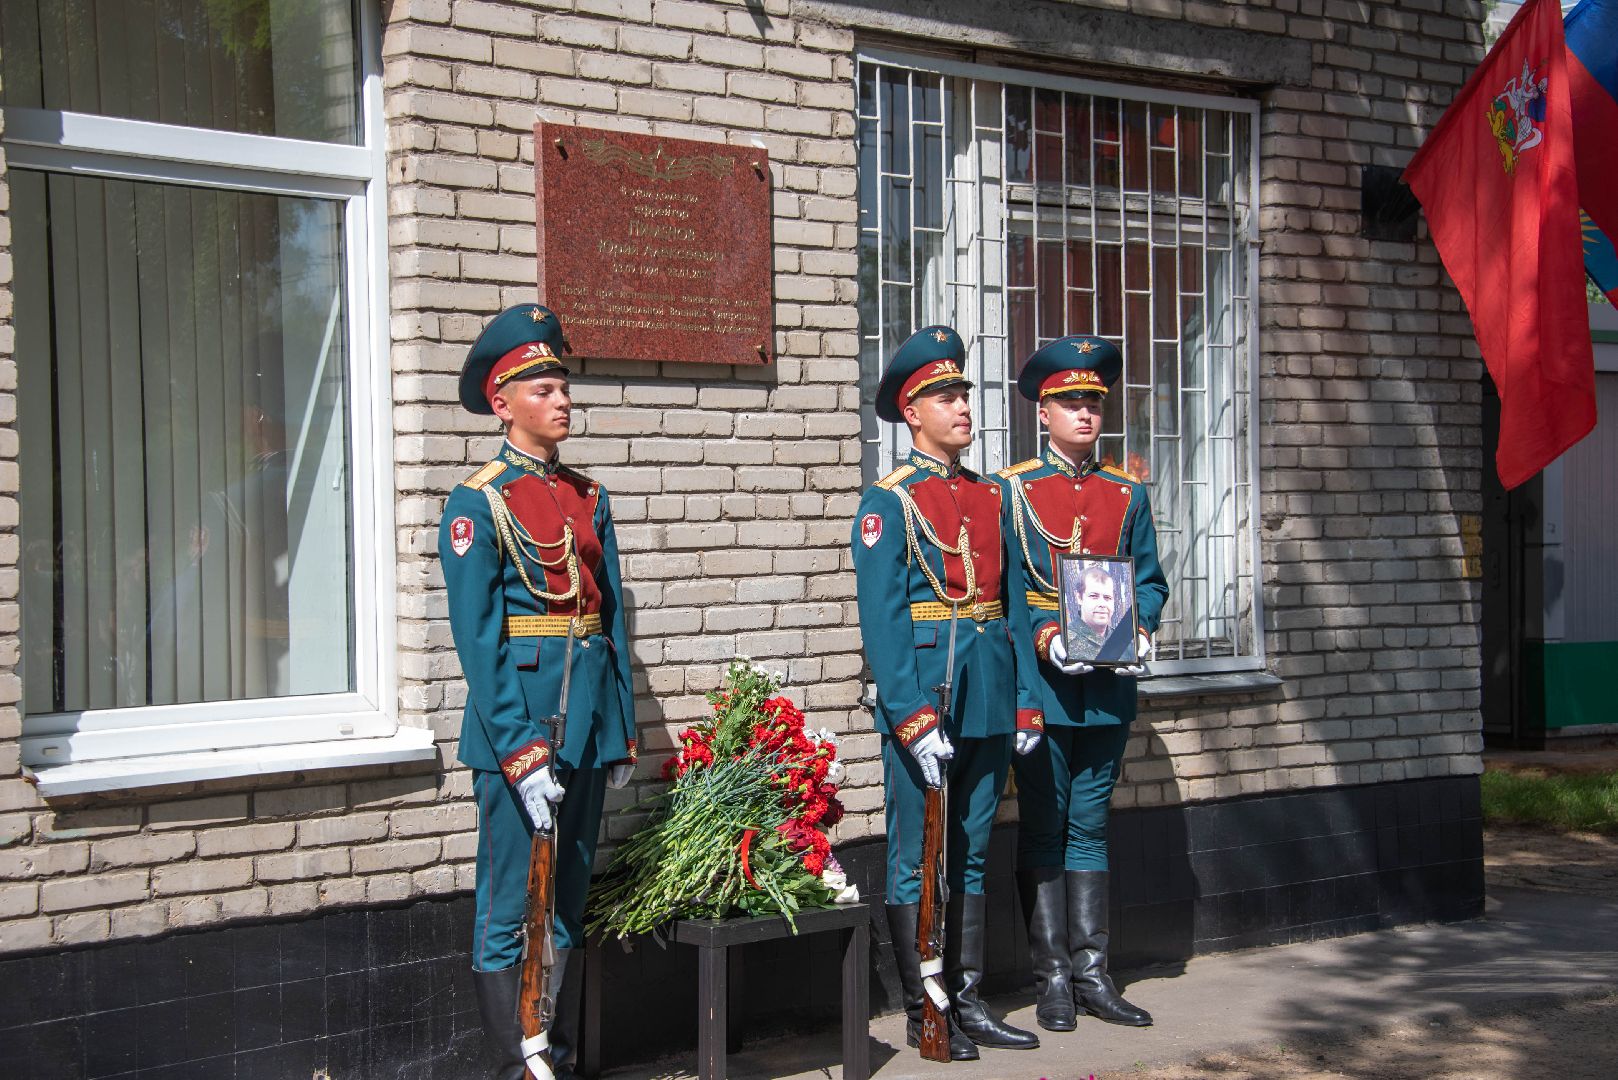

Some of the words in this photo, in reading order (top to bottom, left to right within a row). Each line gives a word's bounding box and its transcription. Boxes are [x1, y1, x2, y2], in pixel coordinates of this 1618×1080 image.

[634, 205, 690, 220] ефрейтор
[598, 238, 639, 257] Юрий
[560, 285, 589, 296] Погиб
[594, 287, 614, 299] при
[572, 301, 597, 312] ходе
[601, 301, 664, 317] Специальной
[561, 314, 614, 328] Посмертно
